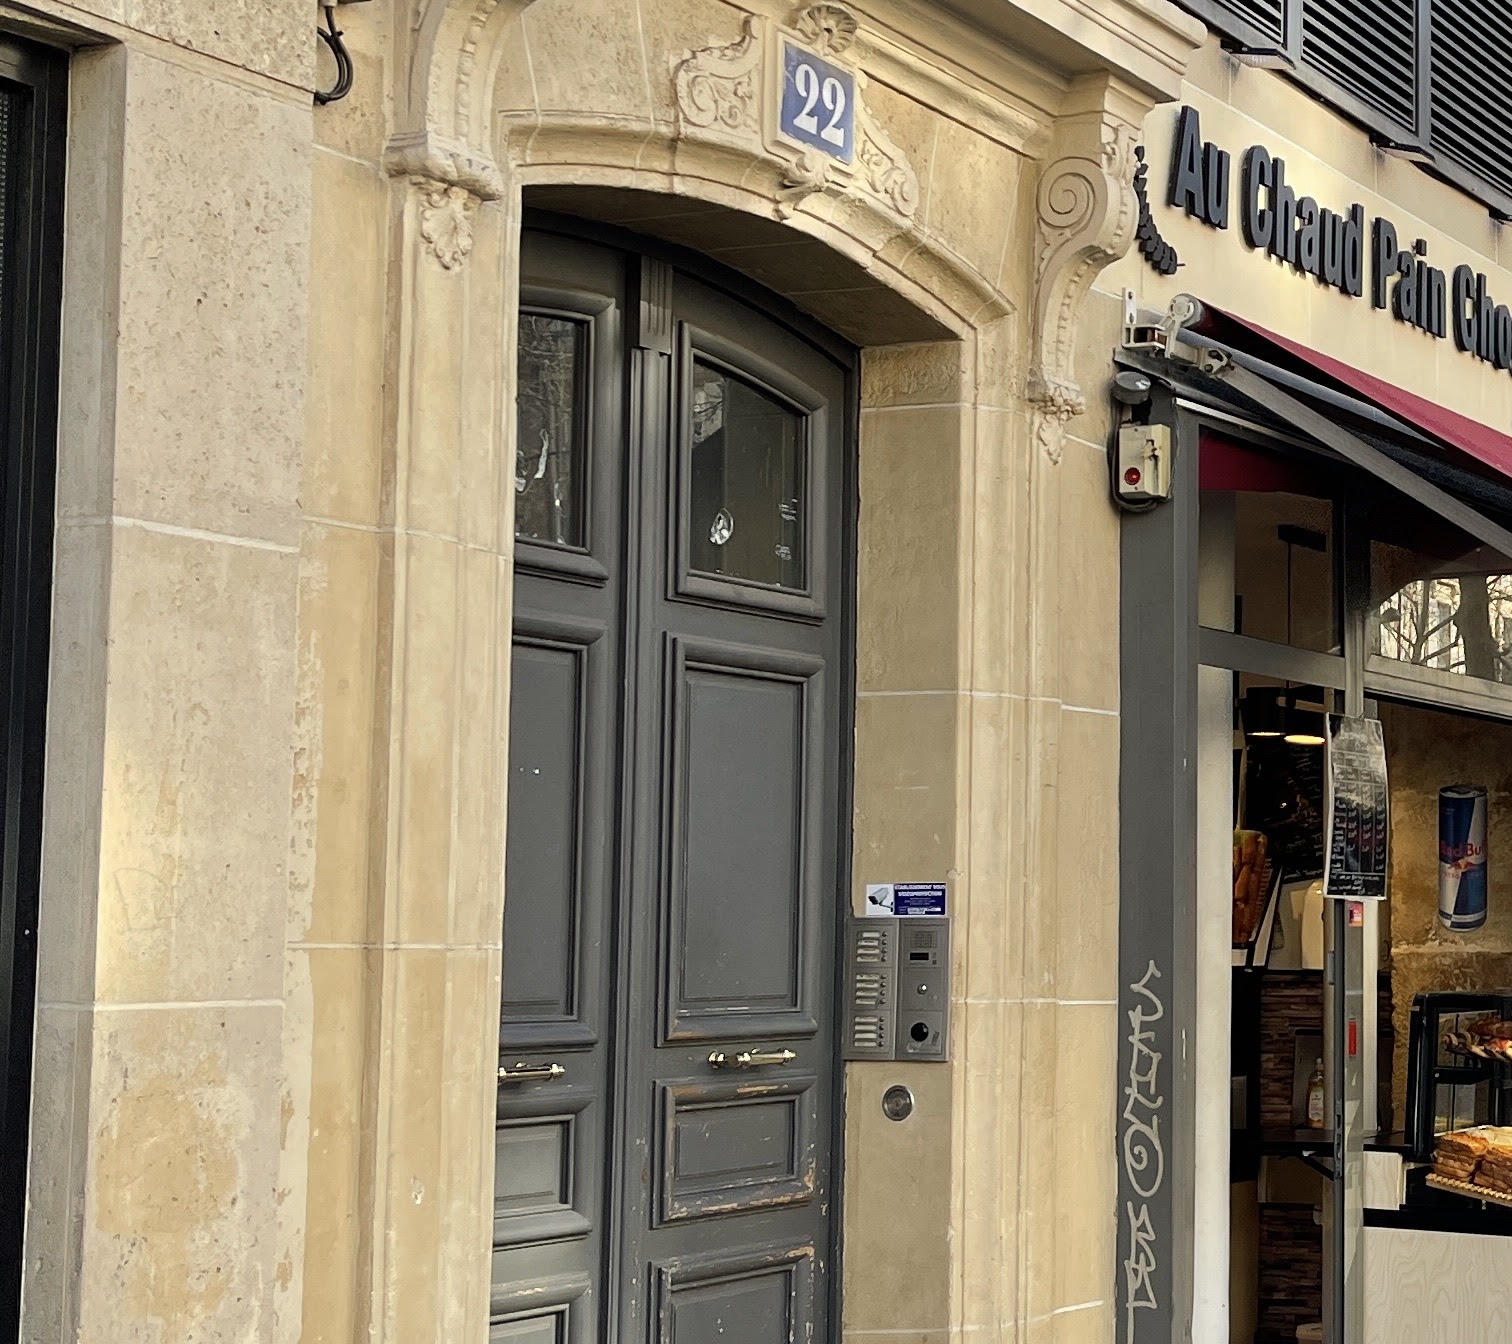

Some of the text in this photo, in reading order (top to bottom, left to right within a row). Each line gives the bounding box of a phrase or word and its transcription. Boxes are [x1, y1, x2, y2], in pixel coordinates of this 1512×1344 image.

[793, 63, 846, 148] 22
[1169, 104, 1231, 230] Au
[1241, 144, 1364, 297] Chaud
[1372, 216, 1447, 339] Pain
